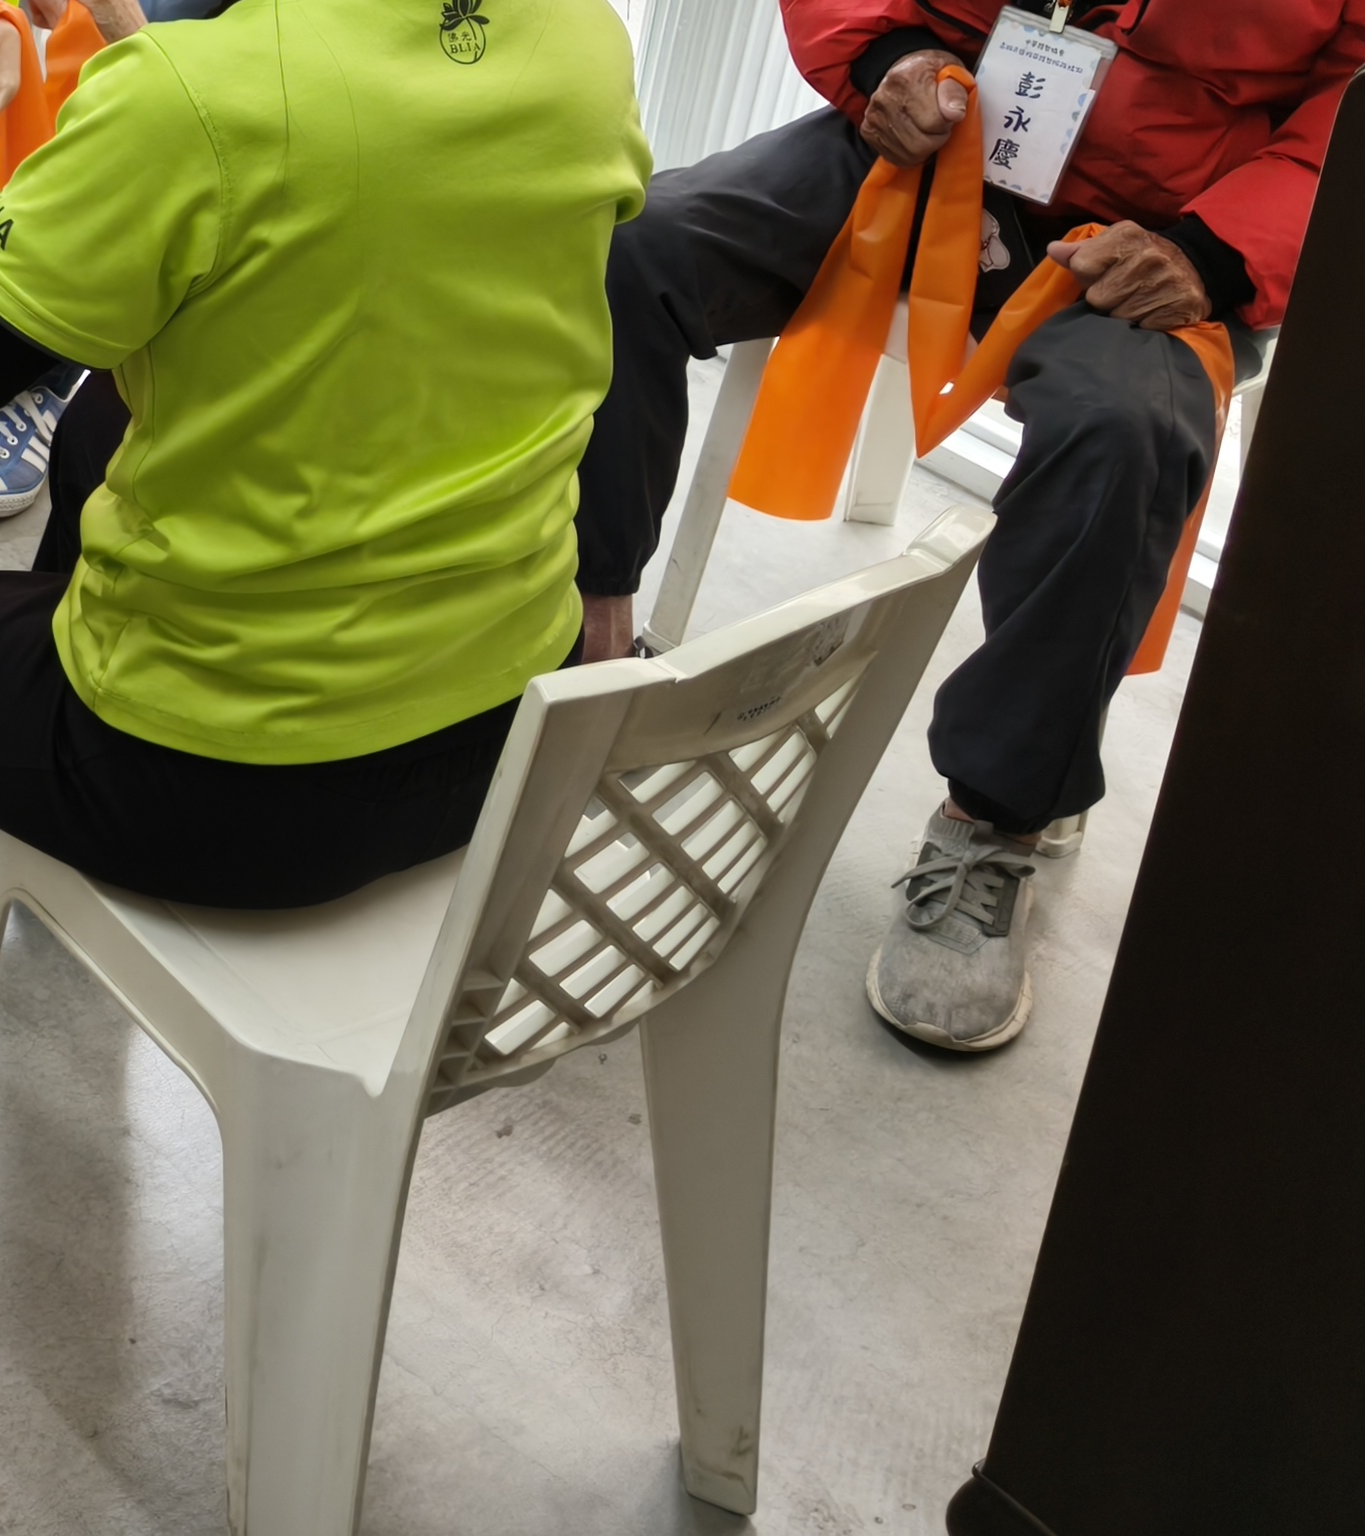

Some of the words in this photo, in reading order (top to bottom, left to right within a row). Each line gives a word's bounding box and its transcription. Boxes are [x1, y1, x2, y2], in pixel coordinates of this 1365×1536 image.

[450, 42, 481, 54] BLIA
[989, 71, 1046, 170] 彭永慶
